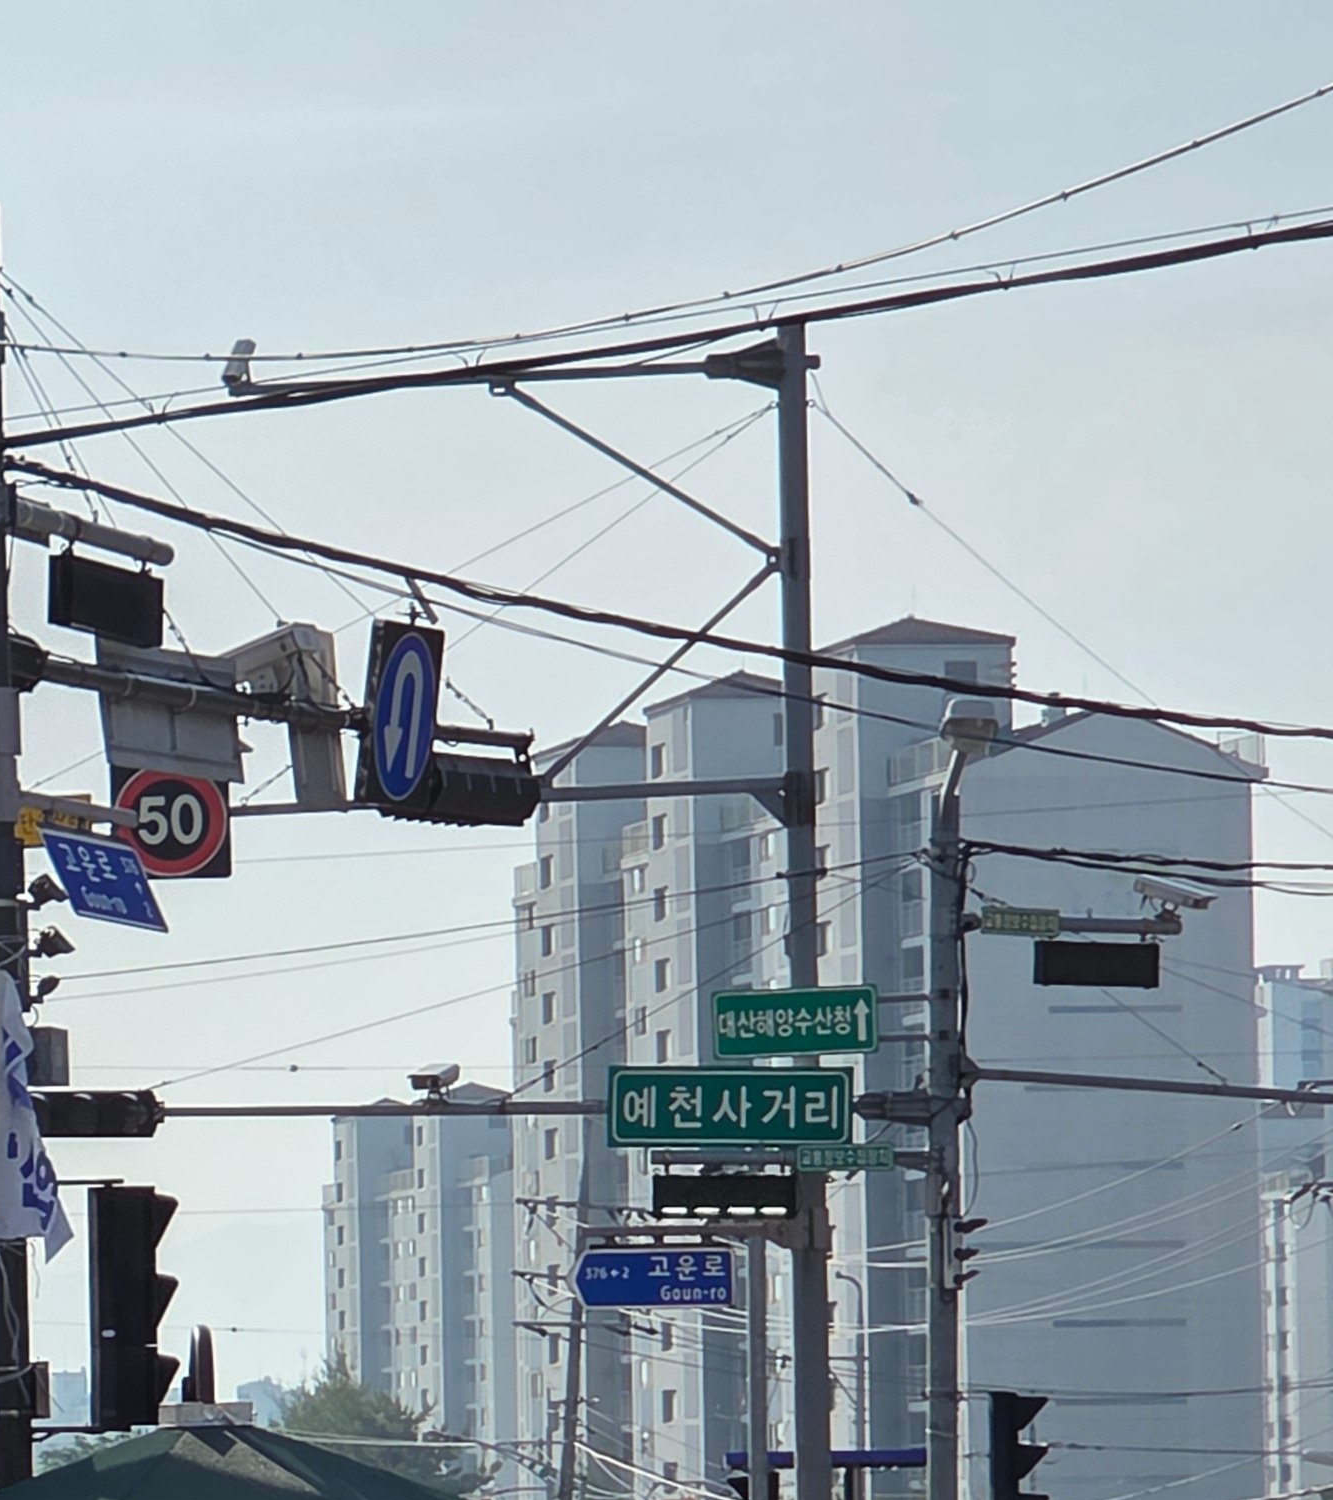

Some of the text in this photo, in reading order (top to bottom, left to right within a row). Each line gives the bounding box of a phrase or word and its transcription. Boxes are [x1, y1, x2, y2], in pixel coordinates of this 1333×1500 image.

[138, 793, 203, 845] 50
[58, 843, 117, 882] 고운로
[718, 1005, 852, 1039] 대산해양수산청
[623, 1085, 839, 1130] 예천사거리
[647, 1255, 726, 1281] 고운로
[659, 1284, 727, 1301] Goun-ro
